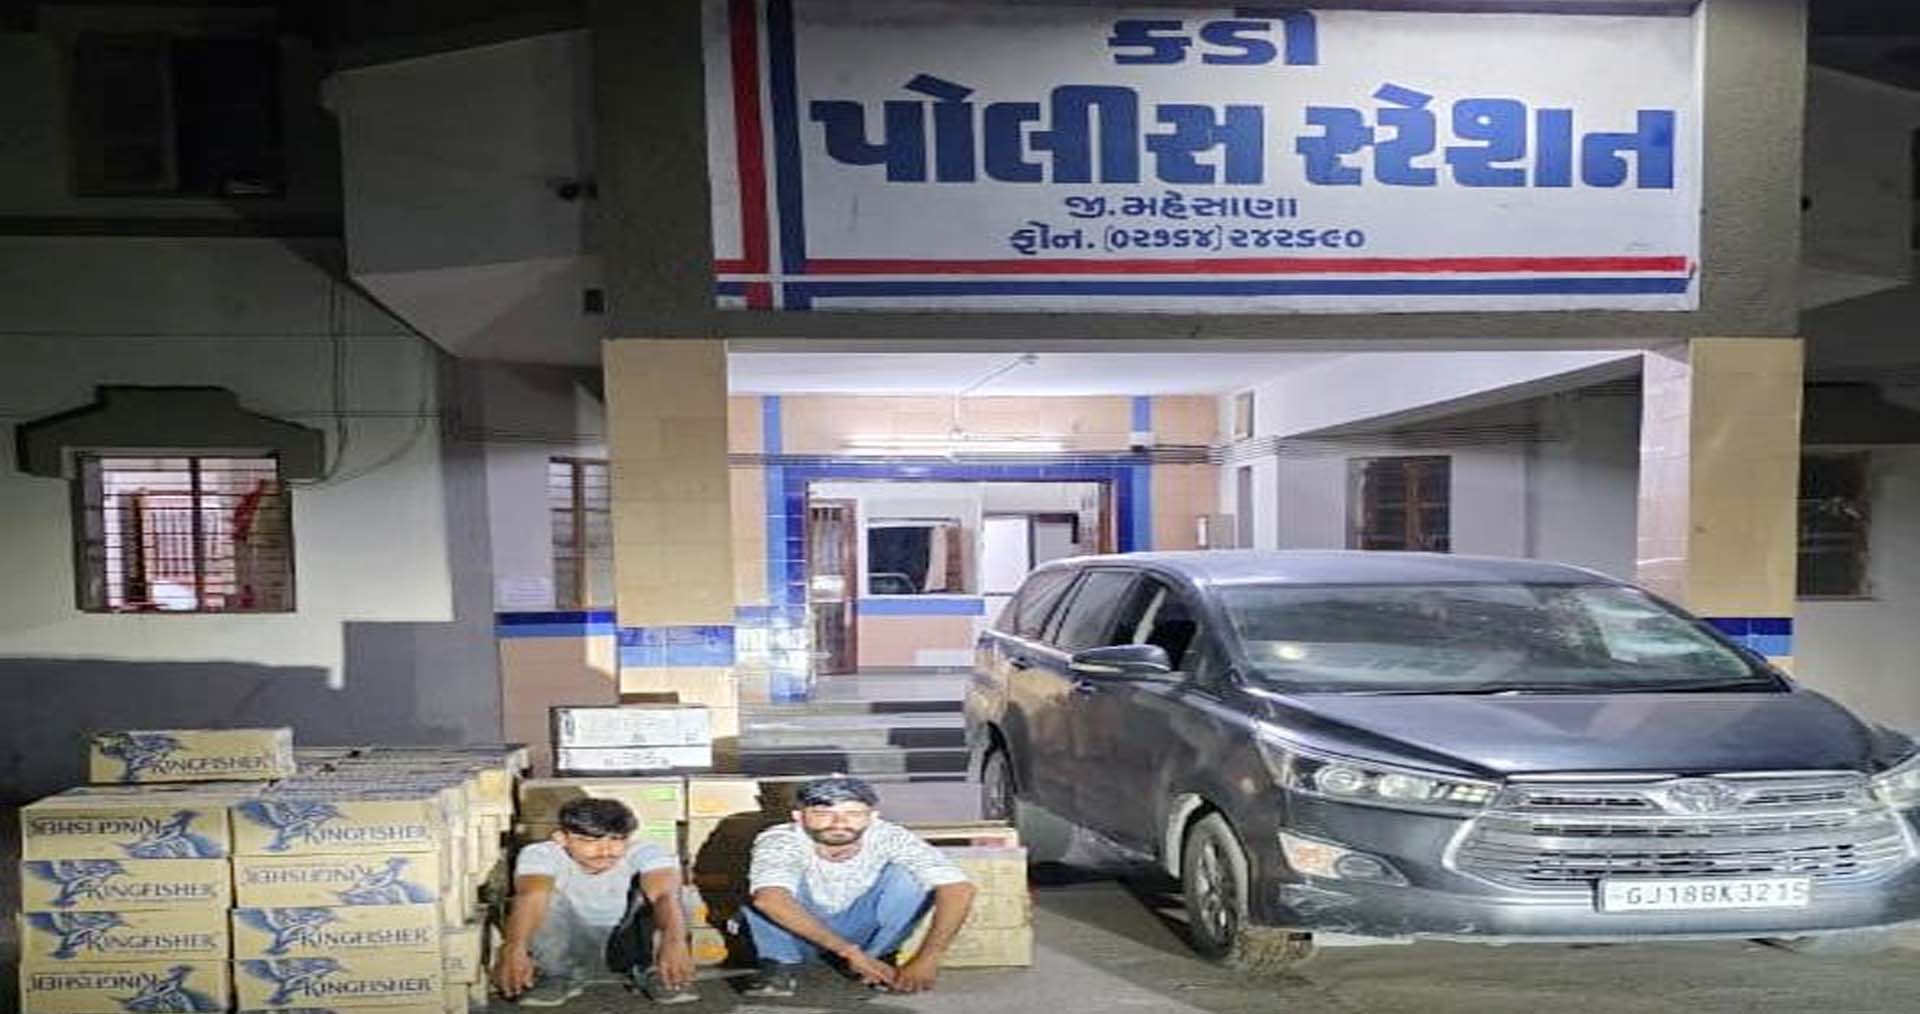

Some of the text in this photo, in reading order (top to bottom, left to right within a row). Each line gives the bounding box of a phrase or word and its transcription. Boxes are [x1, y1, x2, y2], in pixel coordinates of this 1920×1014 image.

[1107, 8, 1318, 65] કડી
[810, 73, 1675, 189] પોલીસ સ્ટેશન
[305, 928, 430, 947] KINGFISHER
[304, 978, 433, 998] KINGFISHER
